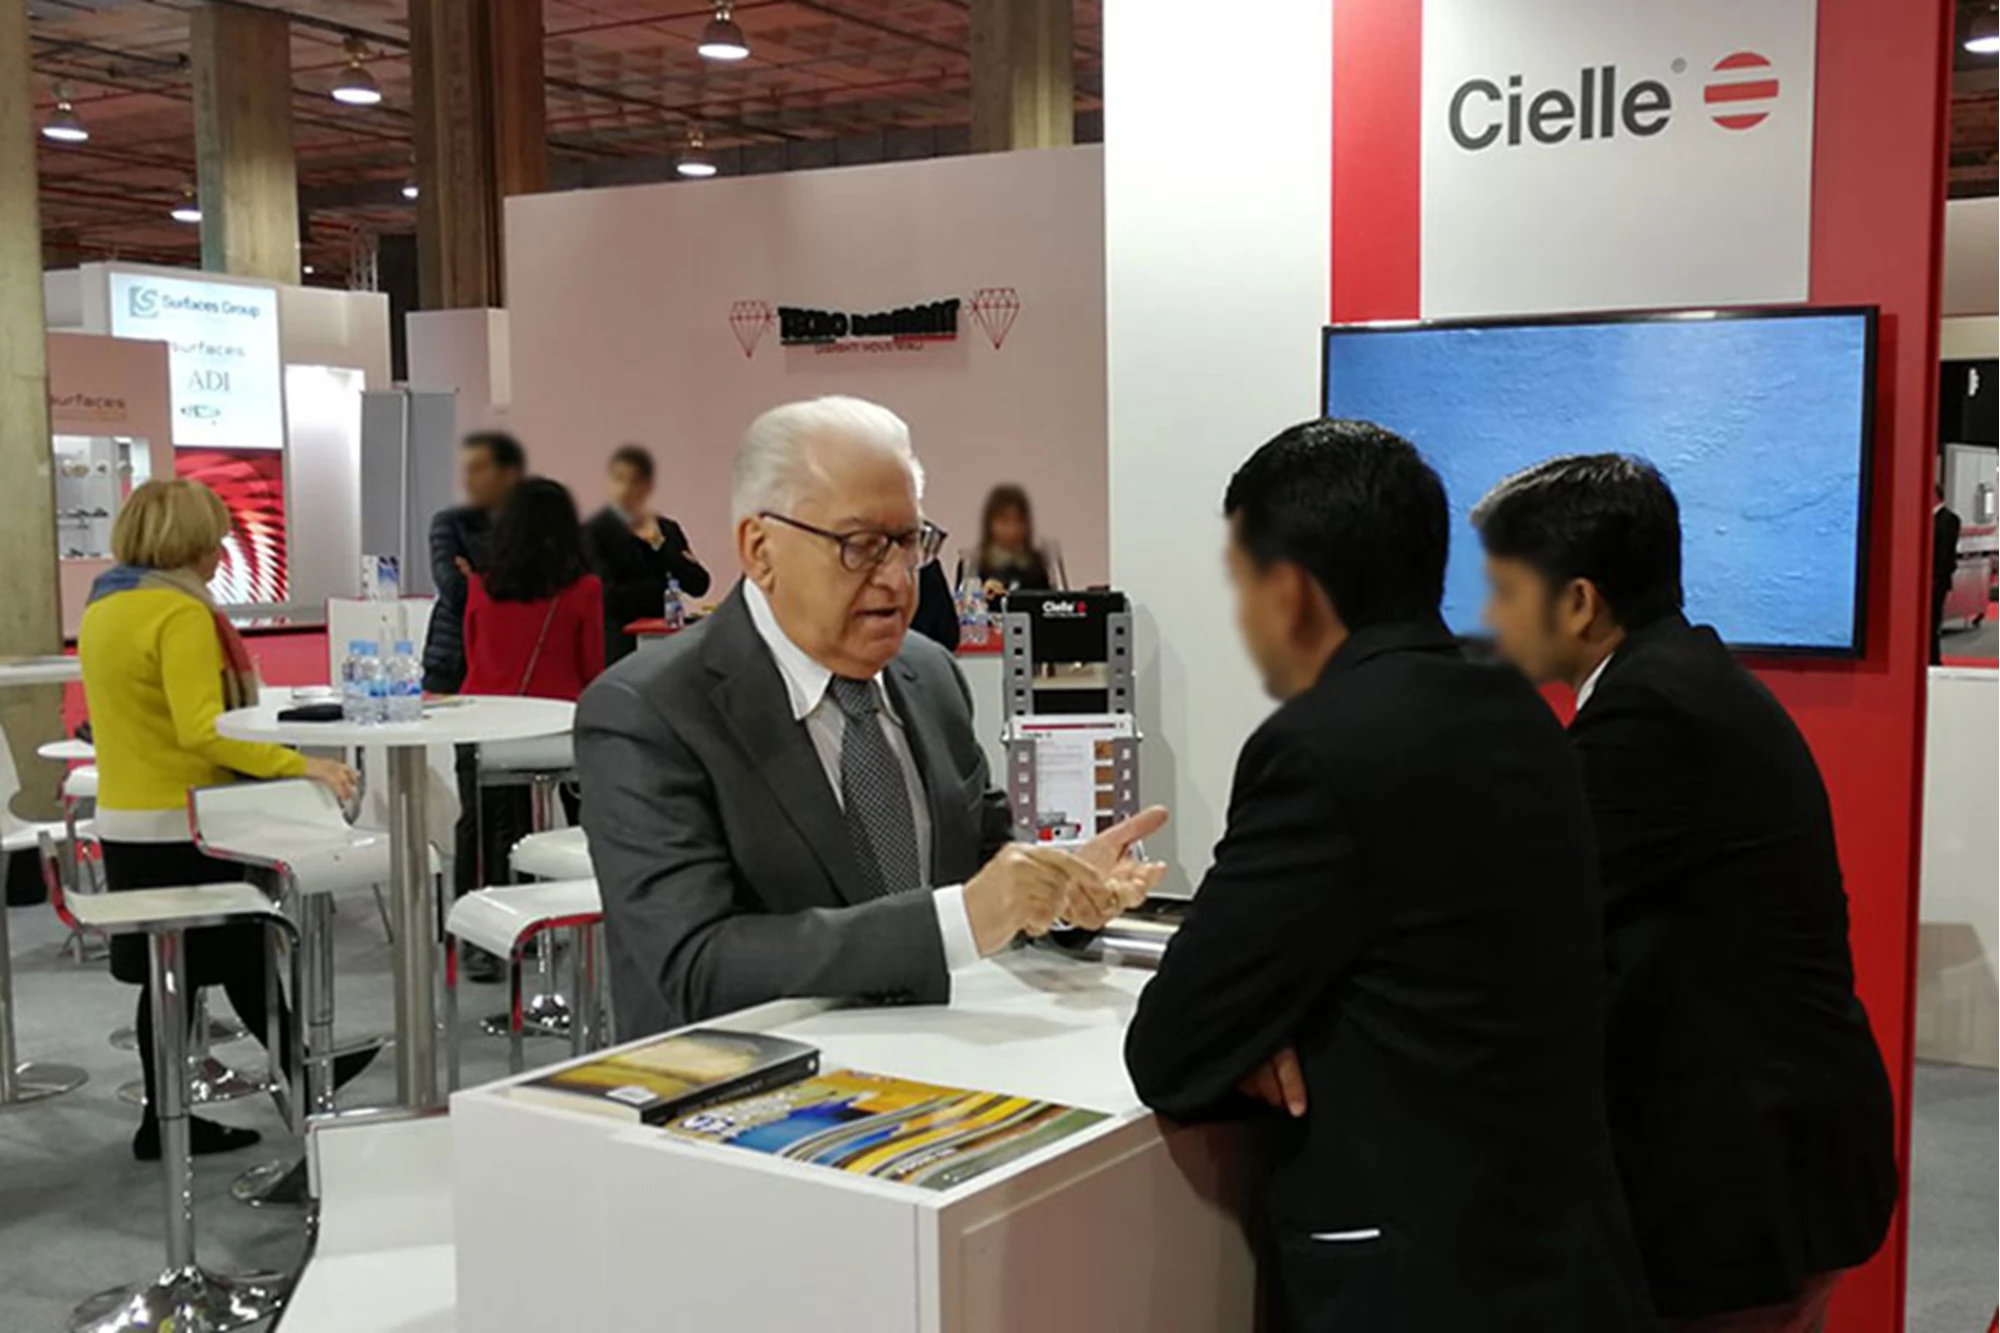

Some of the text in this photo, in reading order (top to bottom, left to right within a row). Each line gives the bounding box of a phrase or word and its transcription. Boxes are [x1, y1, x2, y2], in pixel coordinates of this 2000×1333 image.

[1449, 65, 1672, 150] Cielle
[162, 294, 219, 314] Surfaces
[222, 300, 261, 319] Group
[187, 369, 231, 393] ADI
